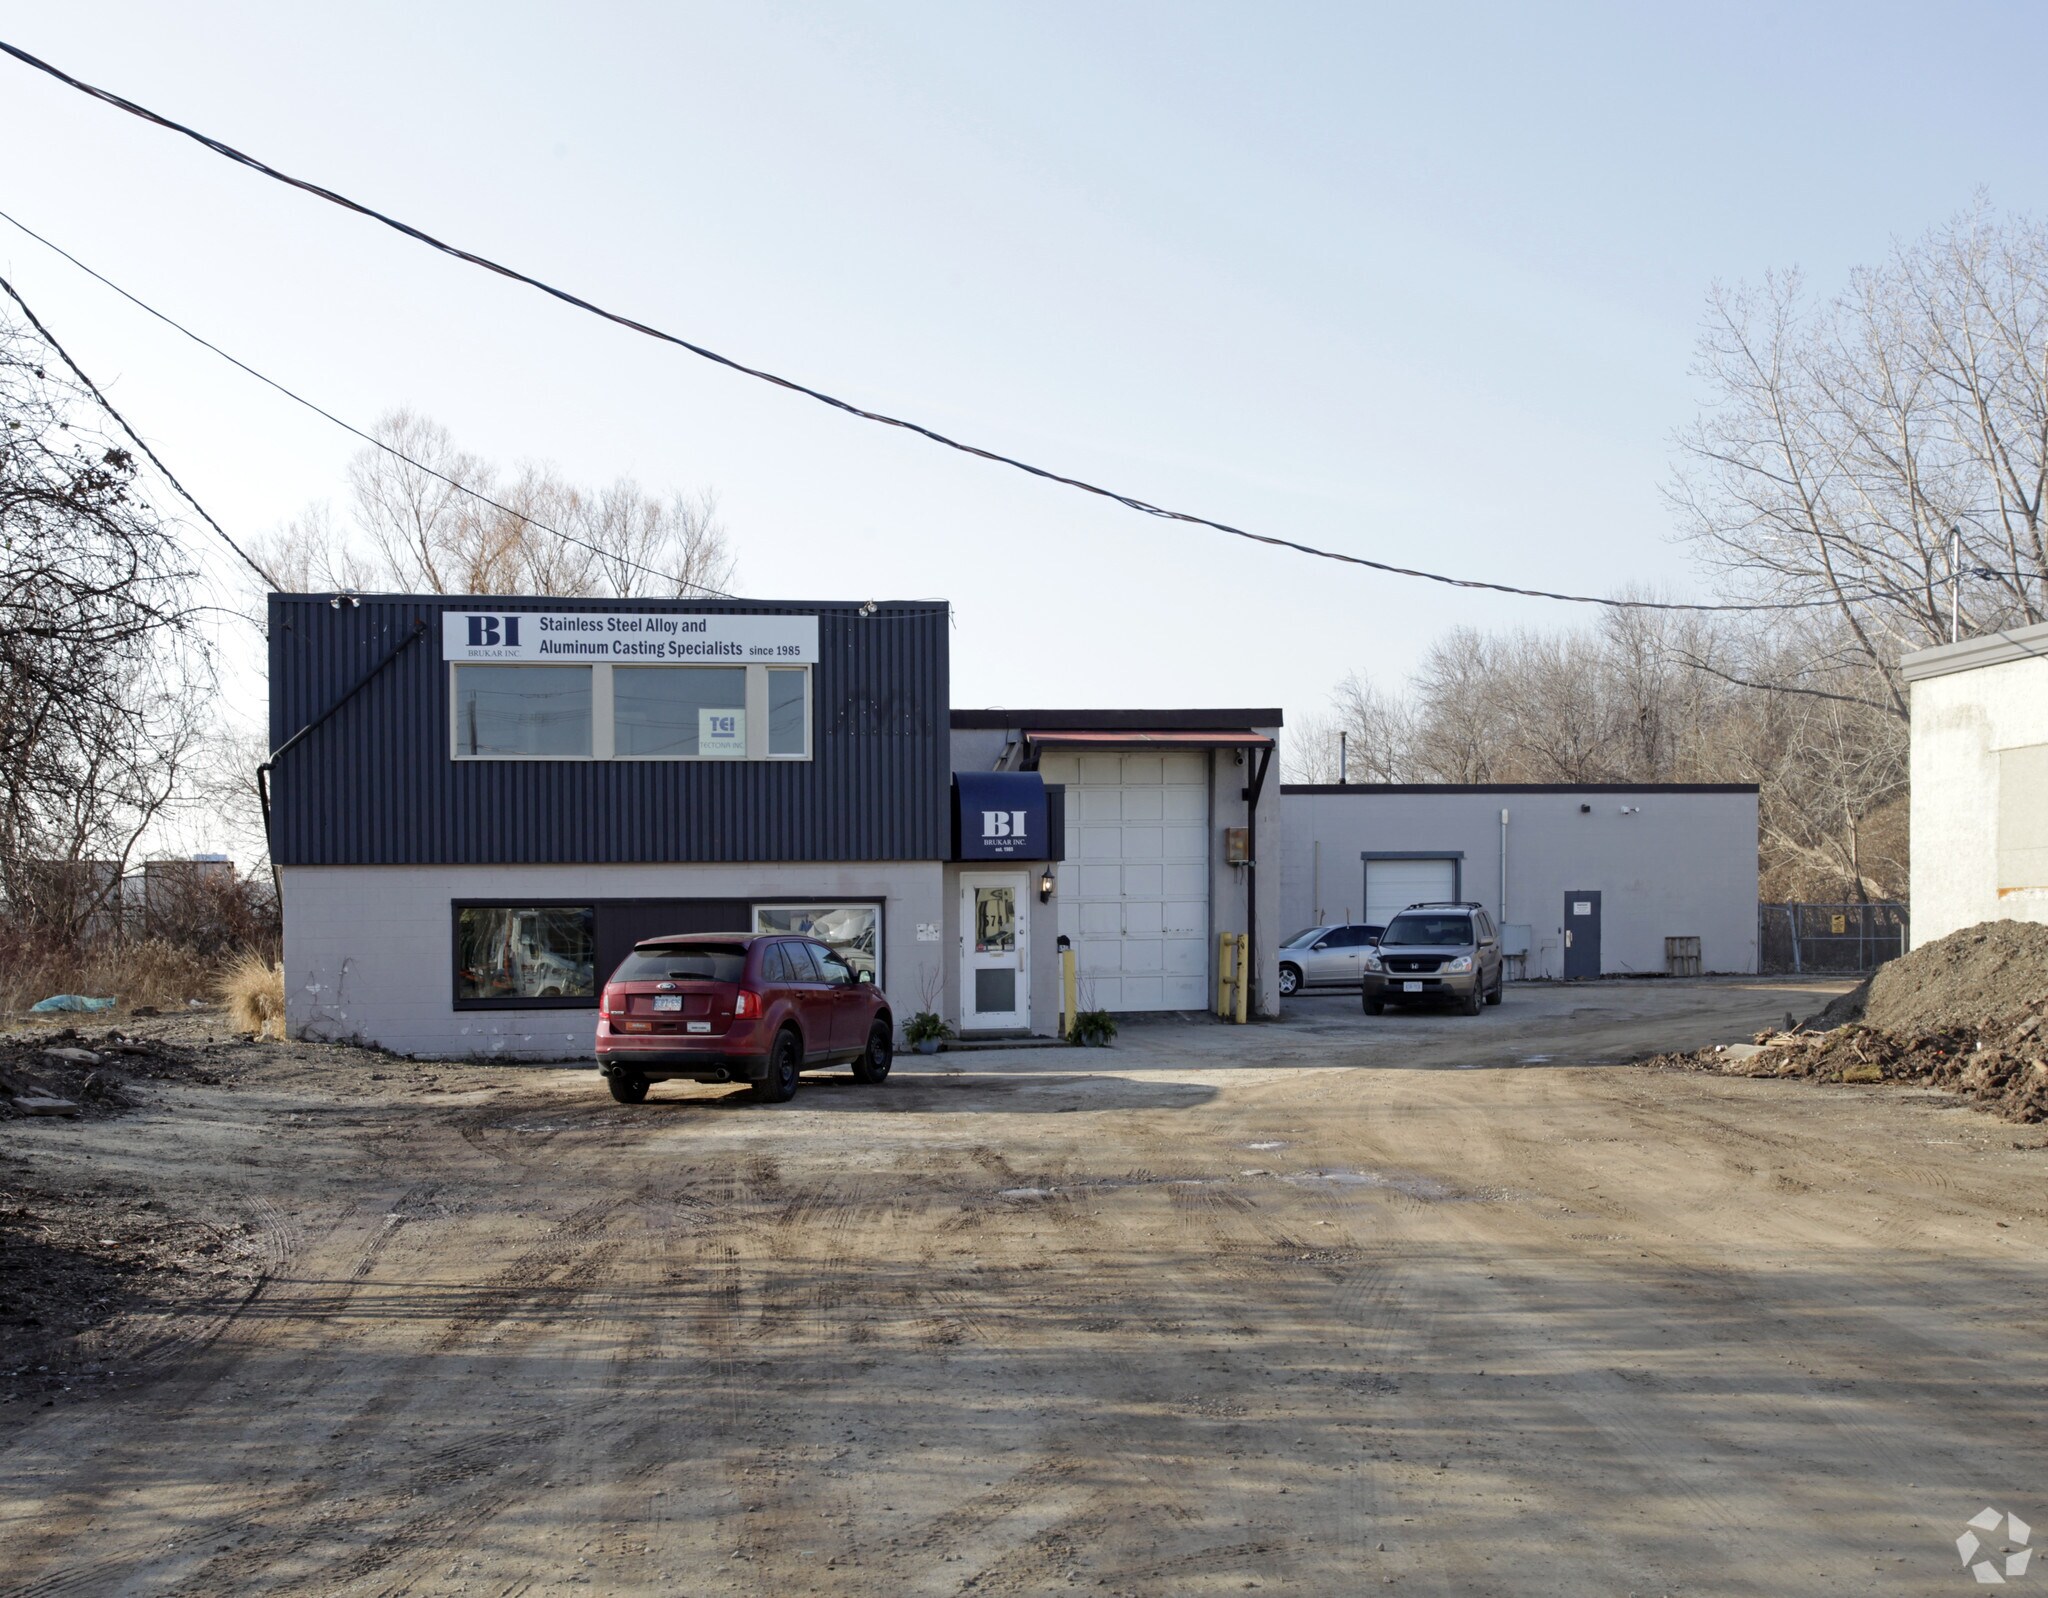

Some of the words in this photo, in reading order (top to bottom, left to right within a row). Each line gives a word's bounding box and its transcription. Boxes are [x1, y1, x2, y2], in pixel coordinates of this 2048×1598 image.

[465, 615, 522, 646] BI
[539, 616, 604, 632] Stainless
[607, 617, 642, 632] Steel
[645, 618, 678, 636] Alloy
[681, 618, 707, 632] and
[539, 639, 609, 654] Aluminum
[612, 640, 665, 658] Casting
[668, 641, 743, 658] Specialists
[749, 645, 774, 656] since
[776, 645, 801, 656] 1985
[709, 716, 735, 731] TEI
[981, 810, 1027, 837] BI
